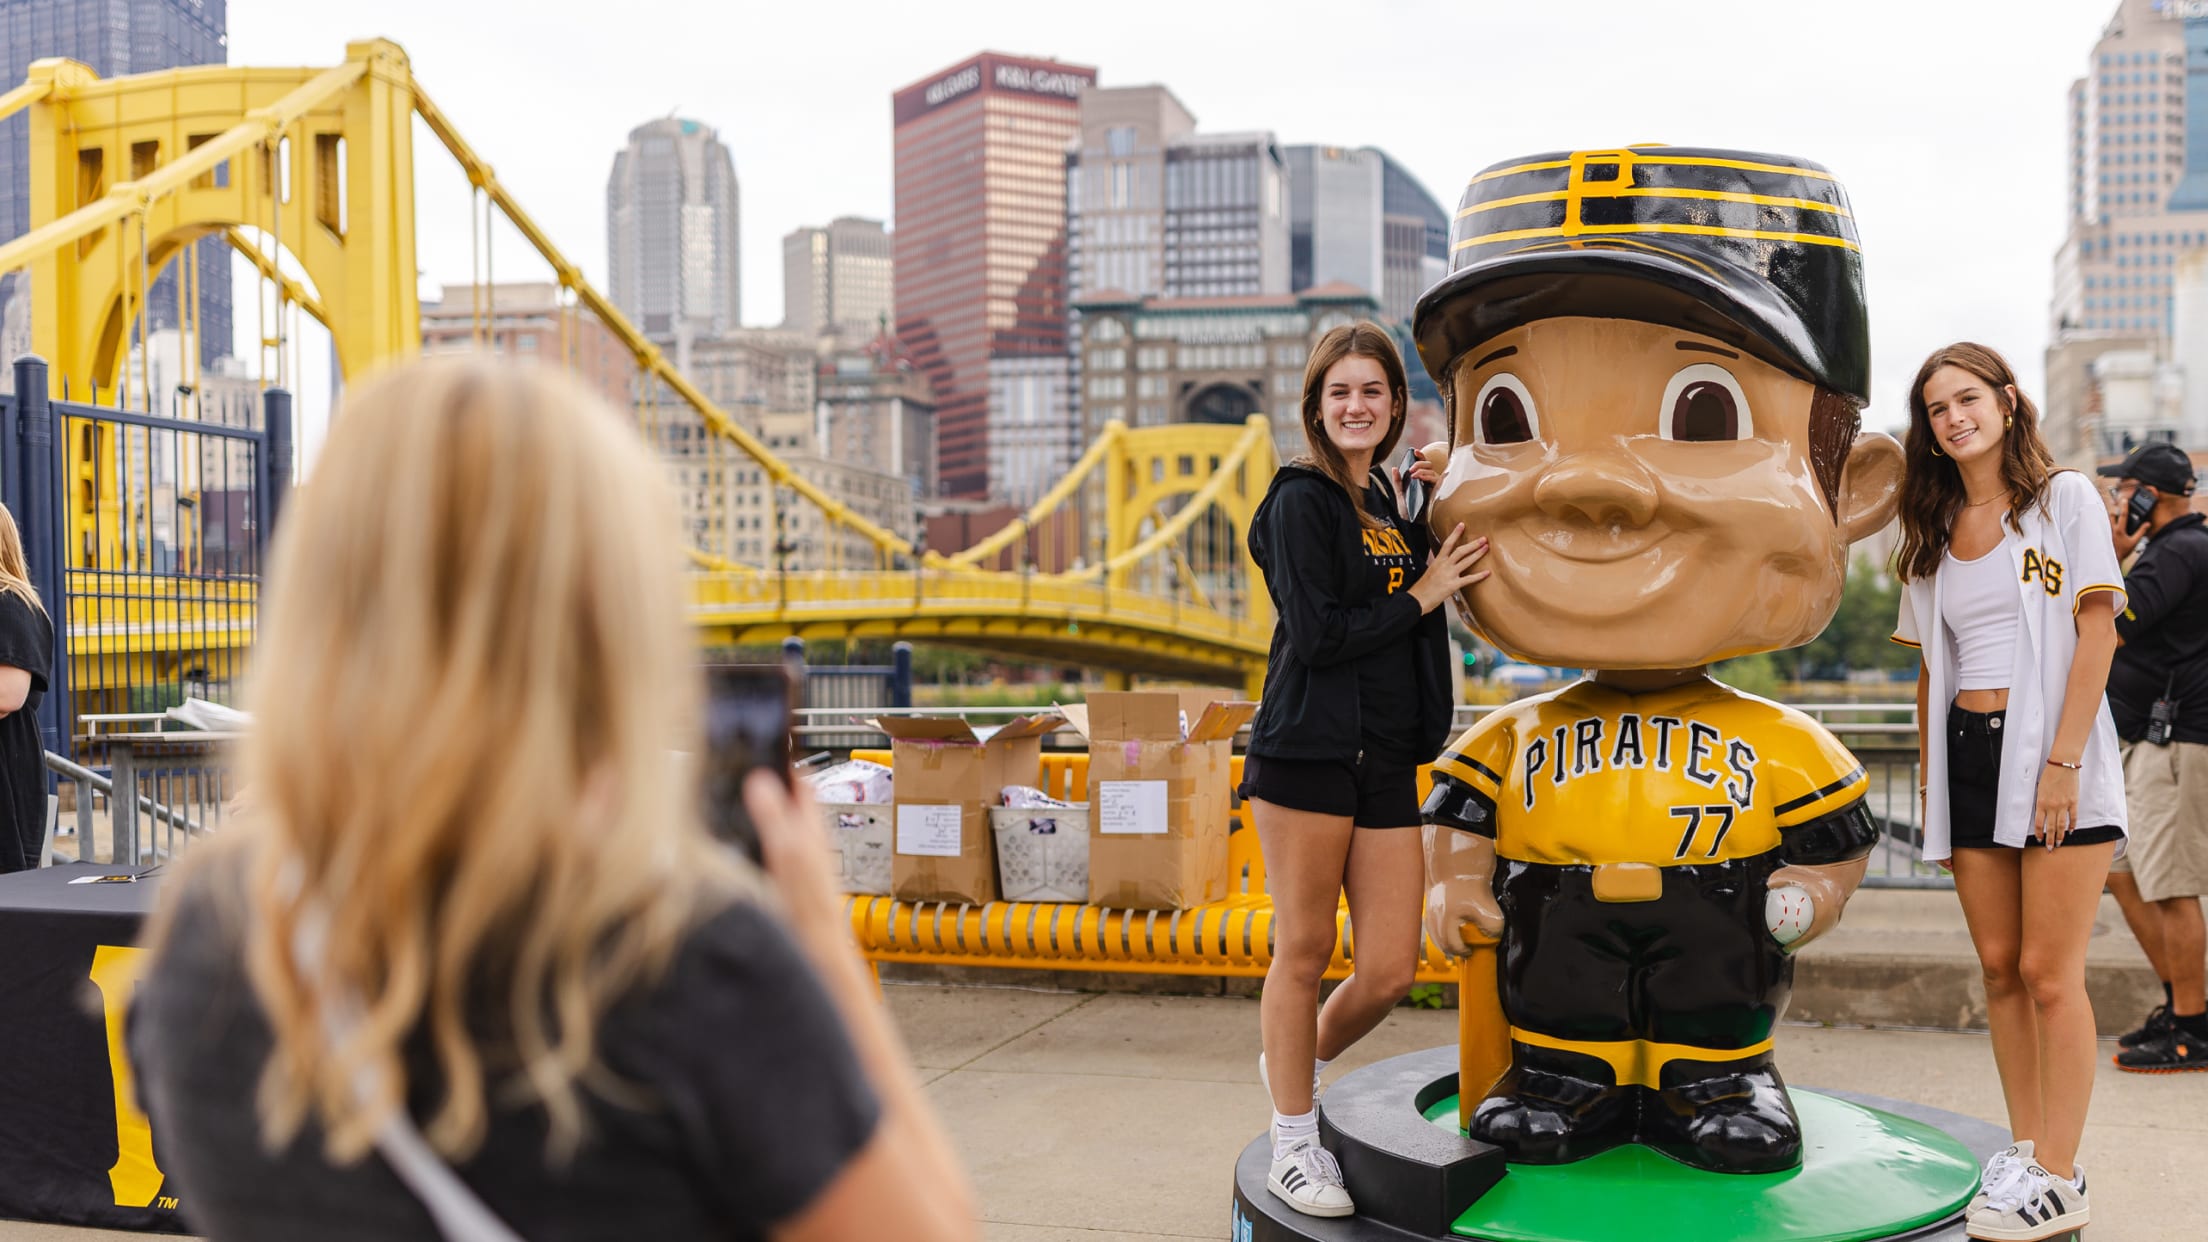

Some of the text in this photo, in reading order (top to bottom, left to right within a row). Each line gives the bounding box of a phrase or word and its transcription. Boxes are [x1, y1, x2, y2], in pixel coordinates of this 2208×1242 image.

[1561, 149, 1639, 237] P
[1525, 713, 1759, 813] PIRATES
[1669, 805, 1735, 860] 77
[157, 1196, 180, 1210] TM
